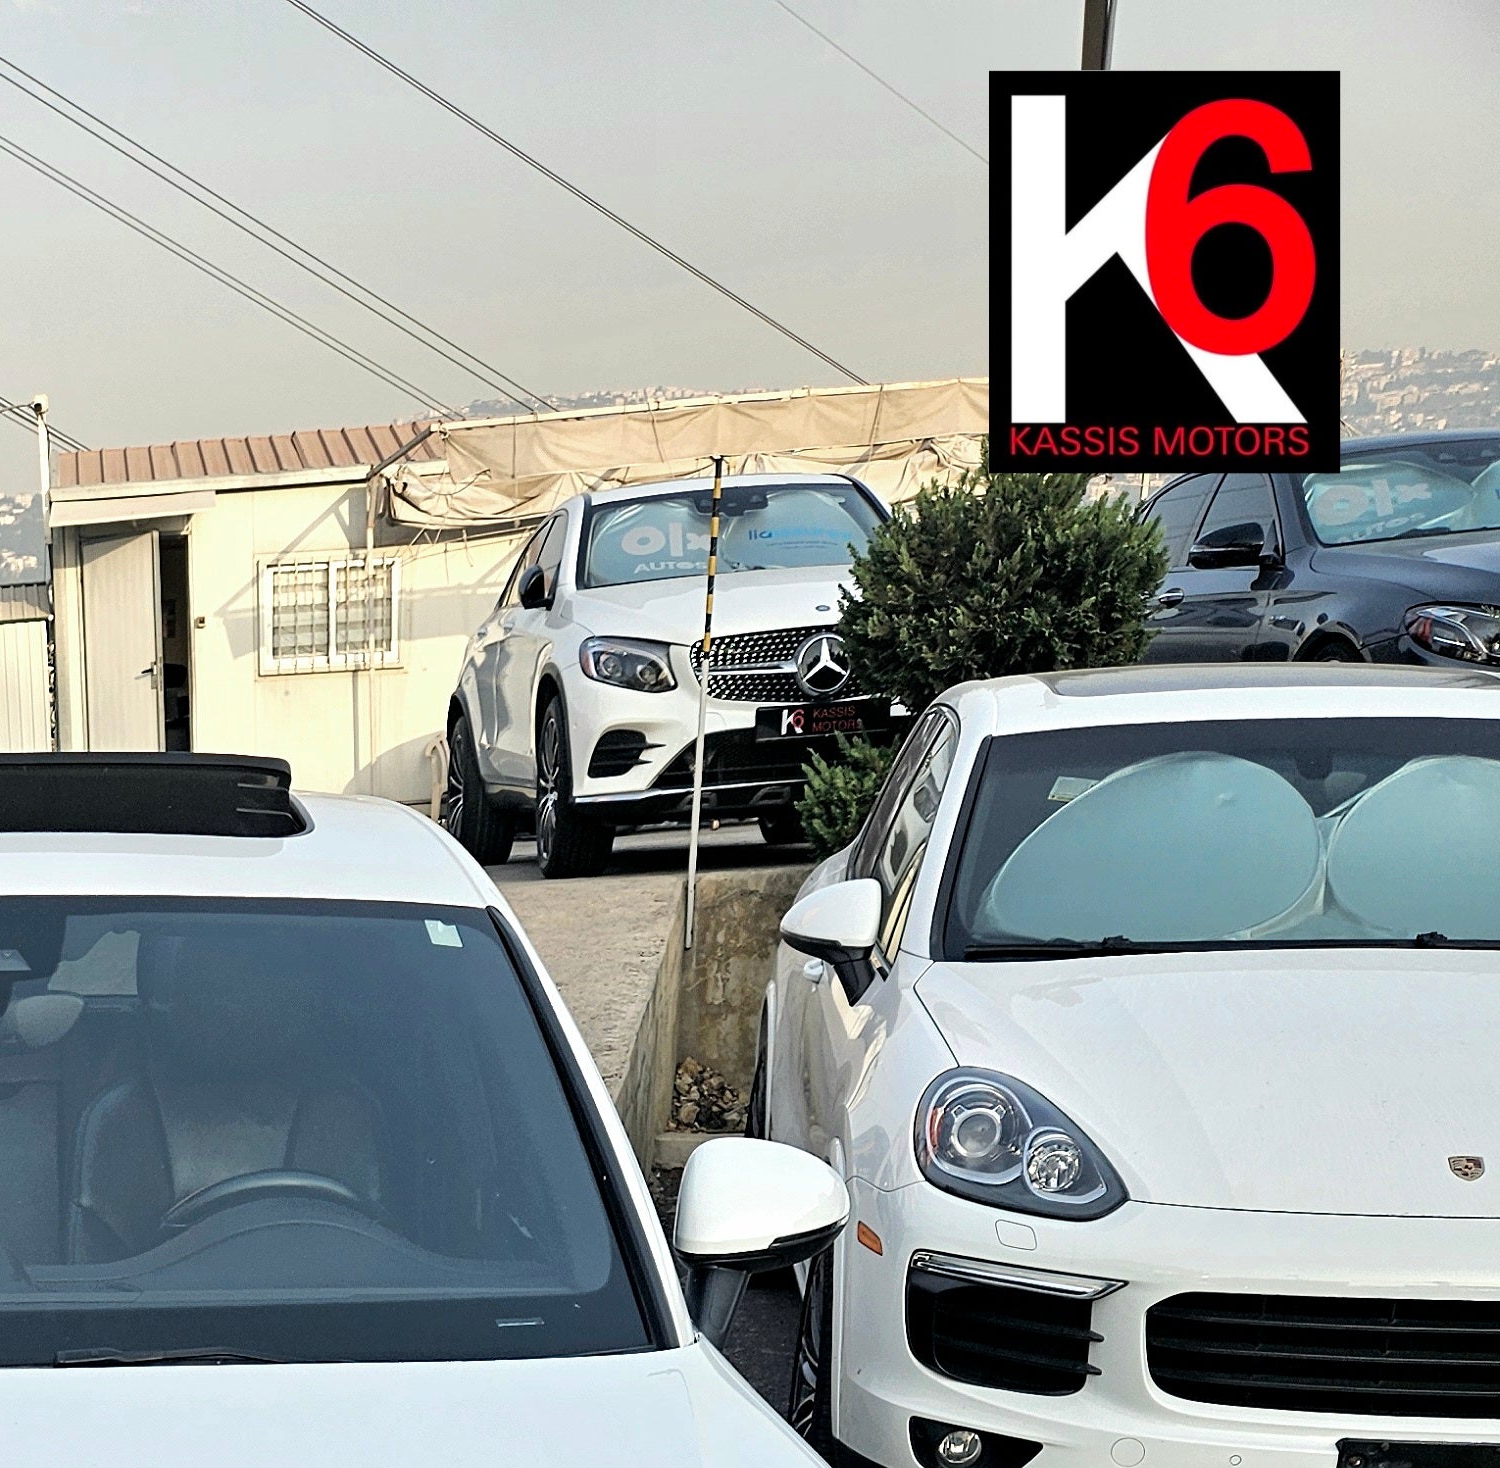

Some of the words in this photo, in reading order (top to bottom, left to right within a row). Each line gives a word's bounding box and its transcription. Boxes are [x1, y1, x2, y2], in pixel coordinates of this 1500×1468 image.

[1315, 478, 1433, 527] olx
[621, 521, 711, 558] olx
[781, 708, 805, 736] K6
[812, 705, 856, 719] KASSIS
